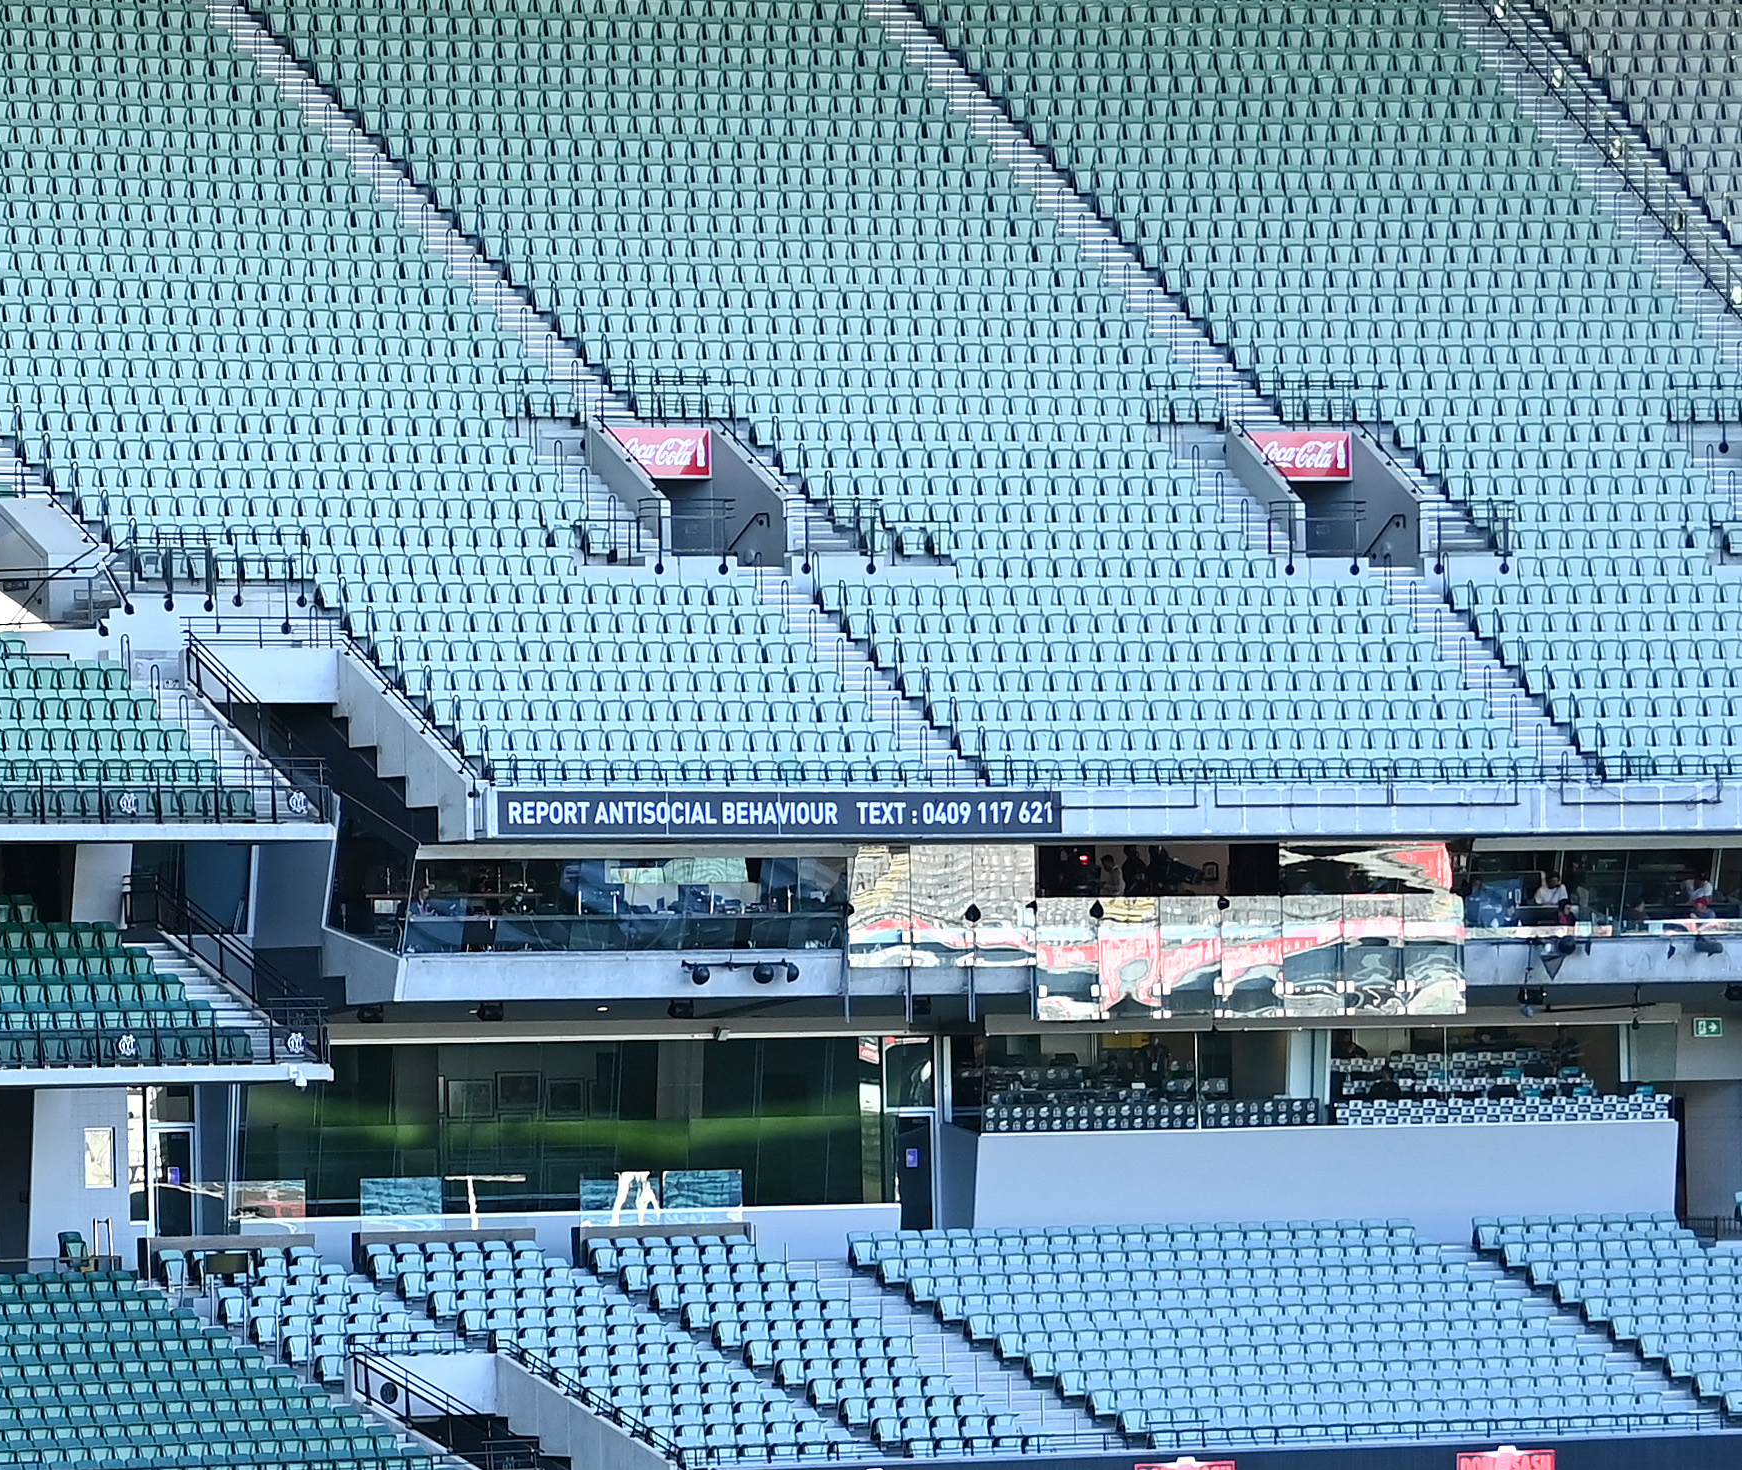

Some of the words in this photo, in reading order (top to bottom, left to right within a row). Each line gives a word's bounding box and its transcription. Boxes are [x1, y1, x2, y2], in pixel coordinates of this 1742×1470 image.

[507, 802, 590, 825] REPORT
[594, 802, 717, 825] ANTISOCIAL
[722, 802, 838, 825] BEHAVIOUR
[856, 802, 906, 825] TEXT
[922, 802, 971, 825] 0409
[976, 802, 1013, 825] 117
[1018, 801, 1053, 825] 621
